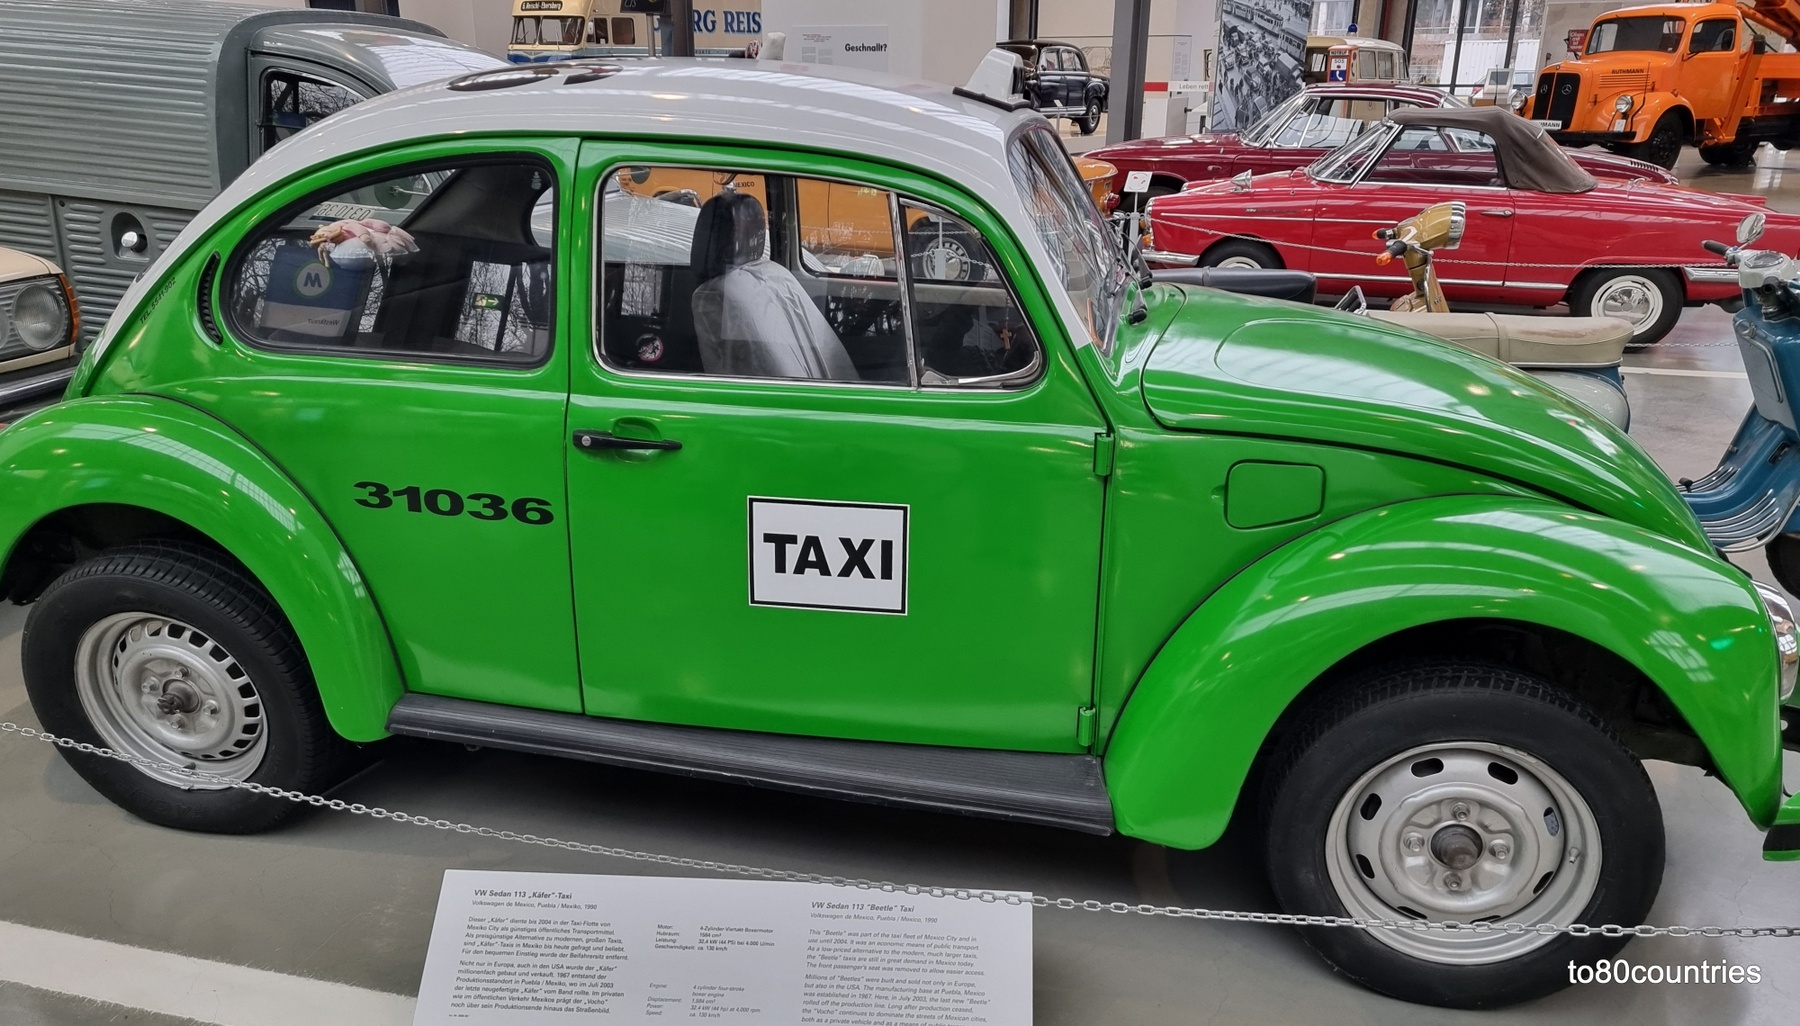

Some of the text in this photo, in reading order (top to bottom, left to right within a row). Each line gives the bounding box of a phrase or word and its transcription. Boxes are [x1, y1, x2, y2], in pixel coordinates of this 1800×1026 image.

[844, 43, 887, 52] Geschnallt?
[353, 481, 554, 525] 31036
[763, 533, 894, 580] TAXI
